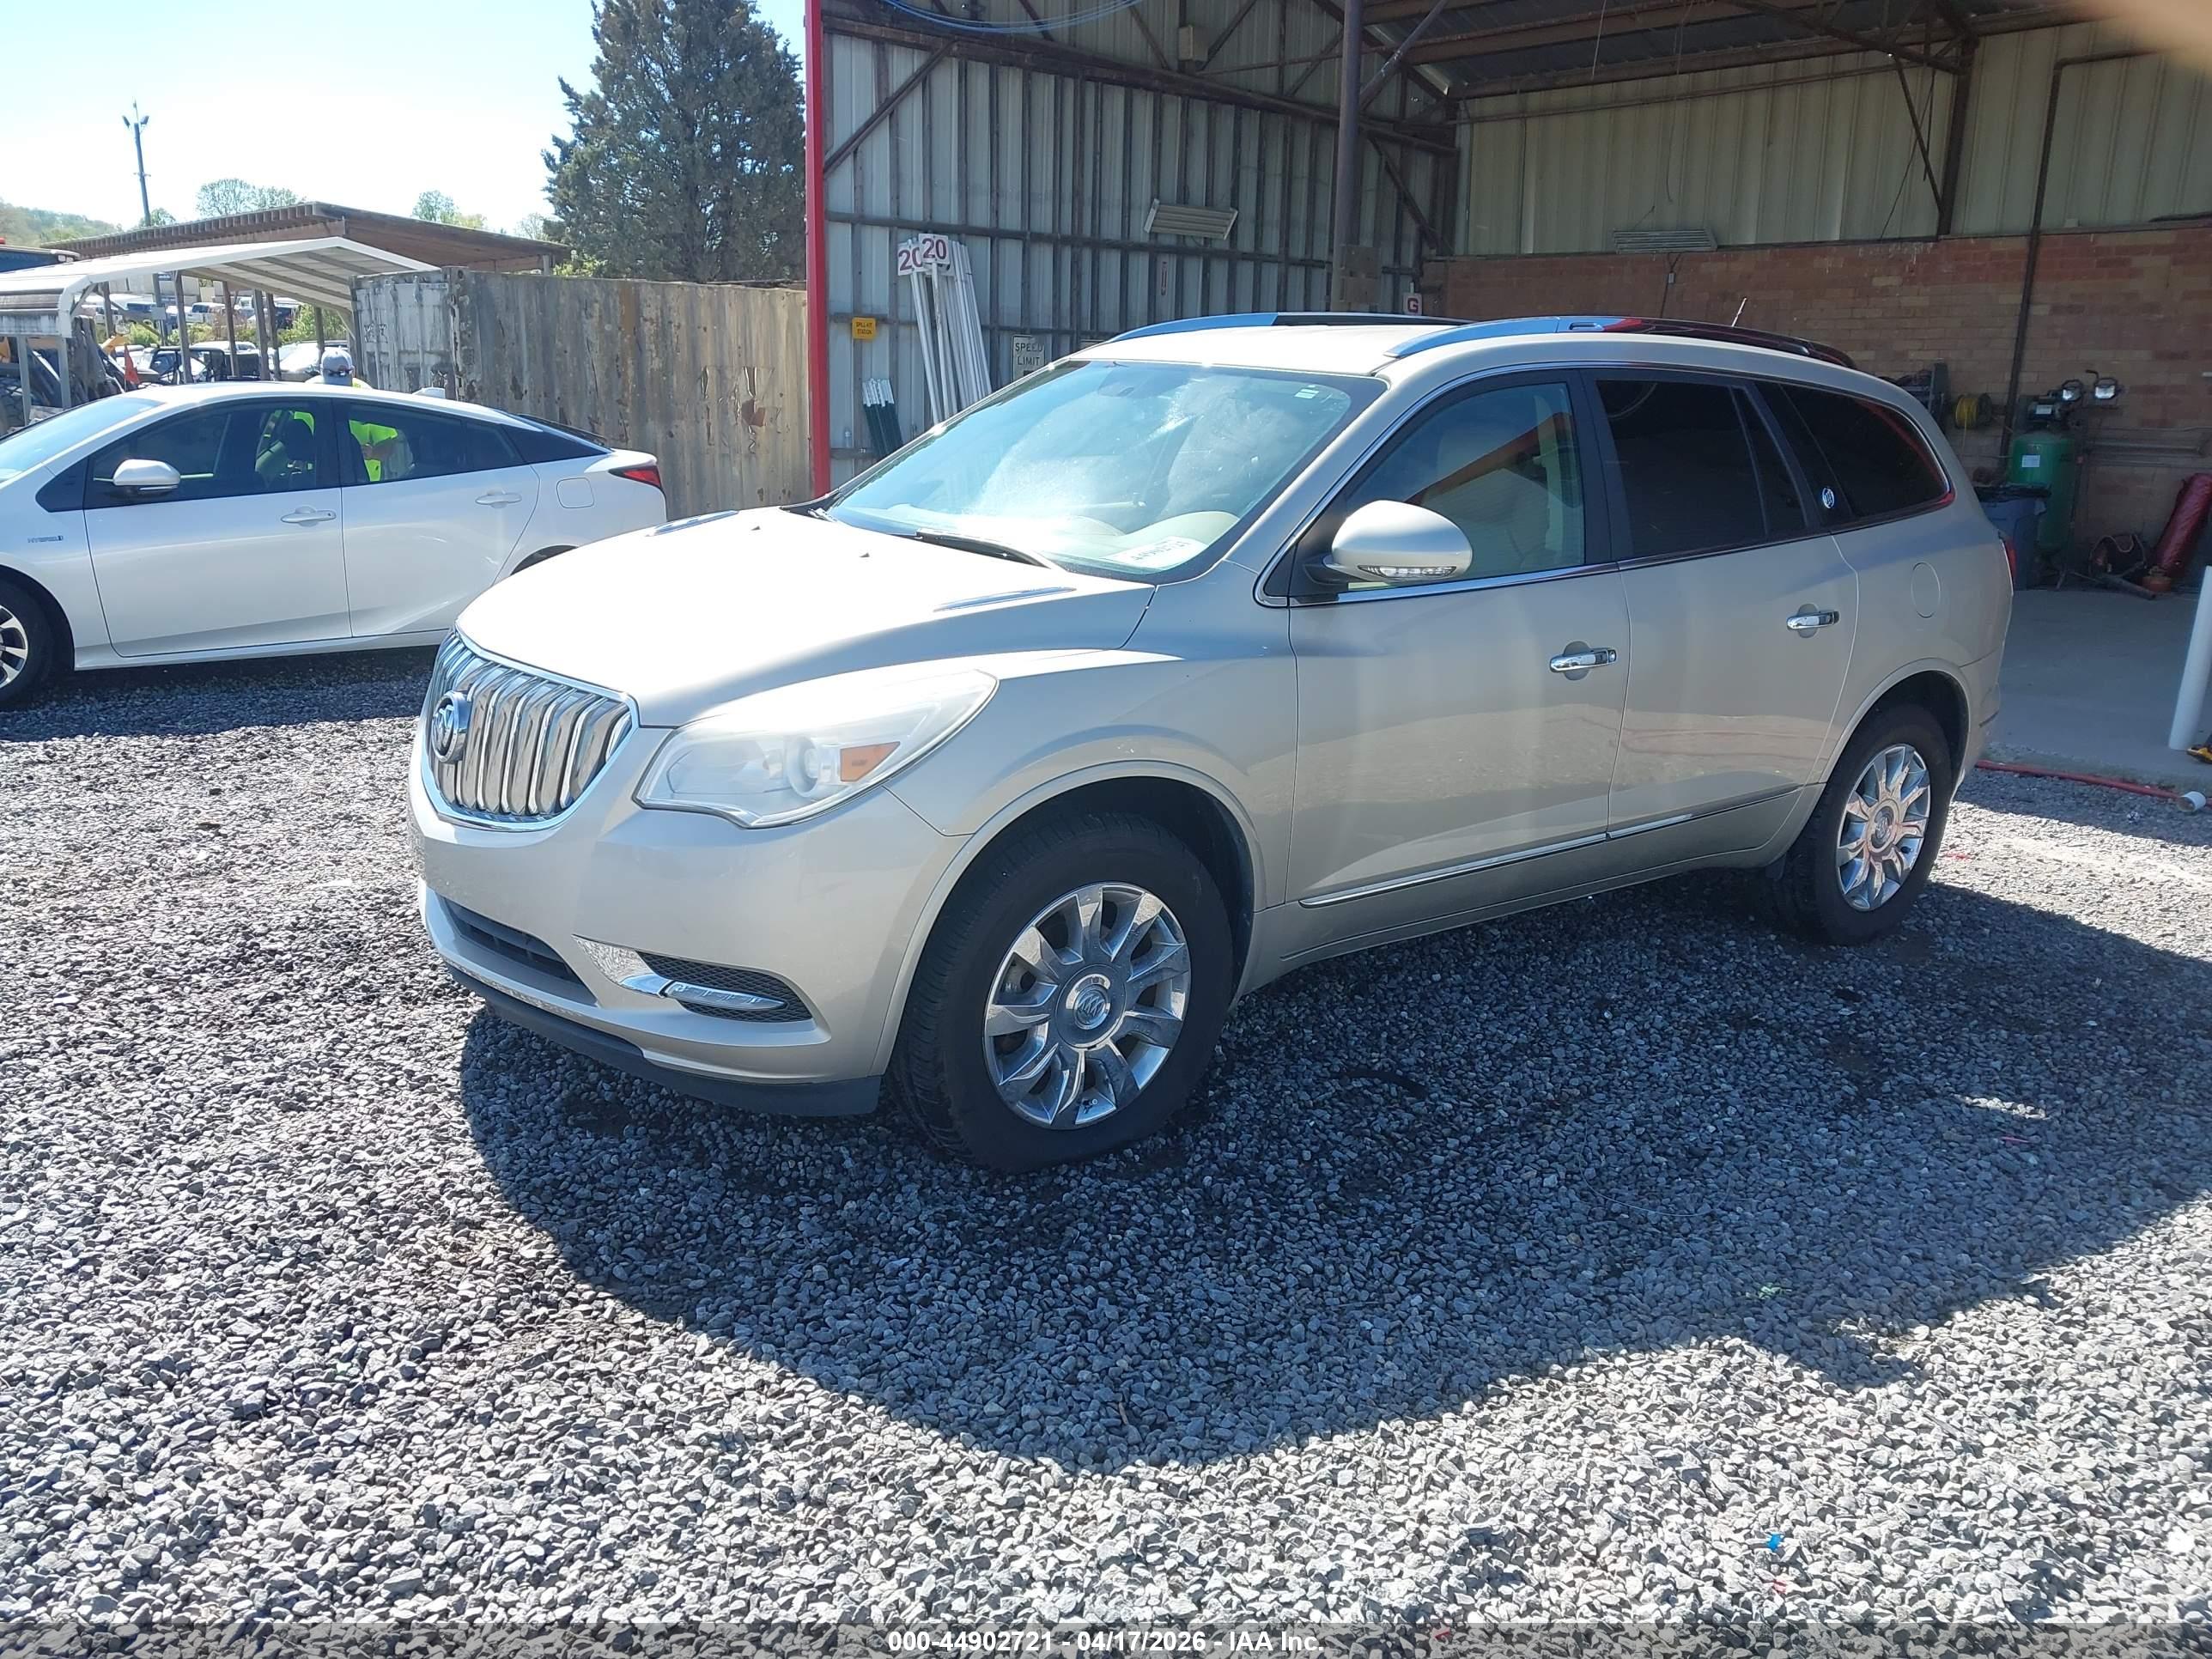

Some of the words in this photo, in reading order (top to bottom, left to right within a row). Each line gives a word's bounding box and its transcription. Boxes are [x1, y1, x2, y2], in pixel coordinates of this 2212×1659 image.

[922, 238, 947, 259] 20
[1407, 297, 1419, 313] G
[1015, 343, 1043, 351] SPEED
[1017, 356, 1040, 365] LIMIT
